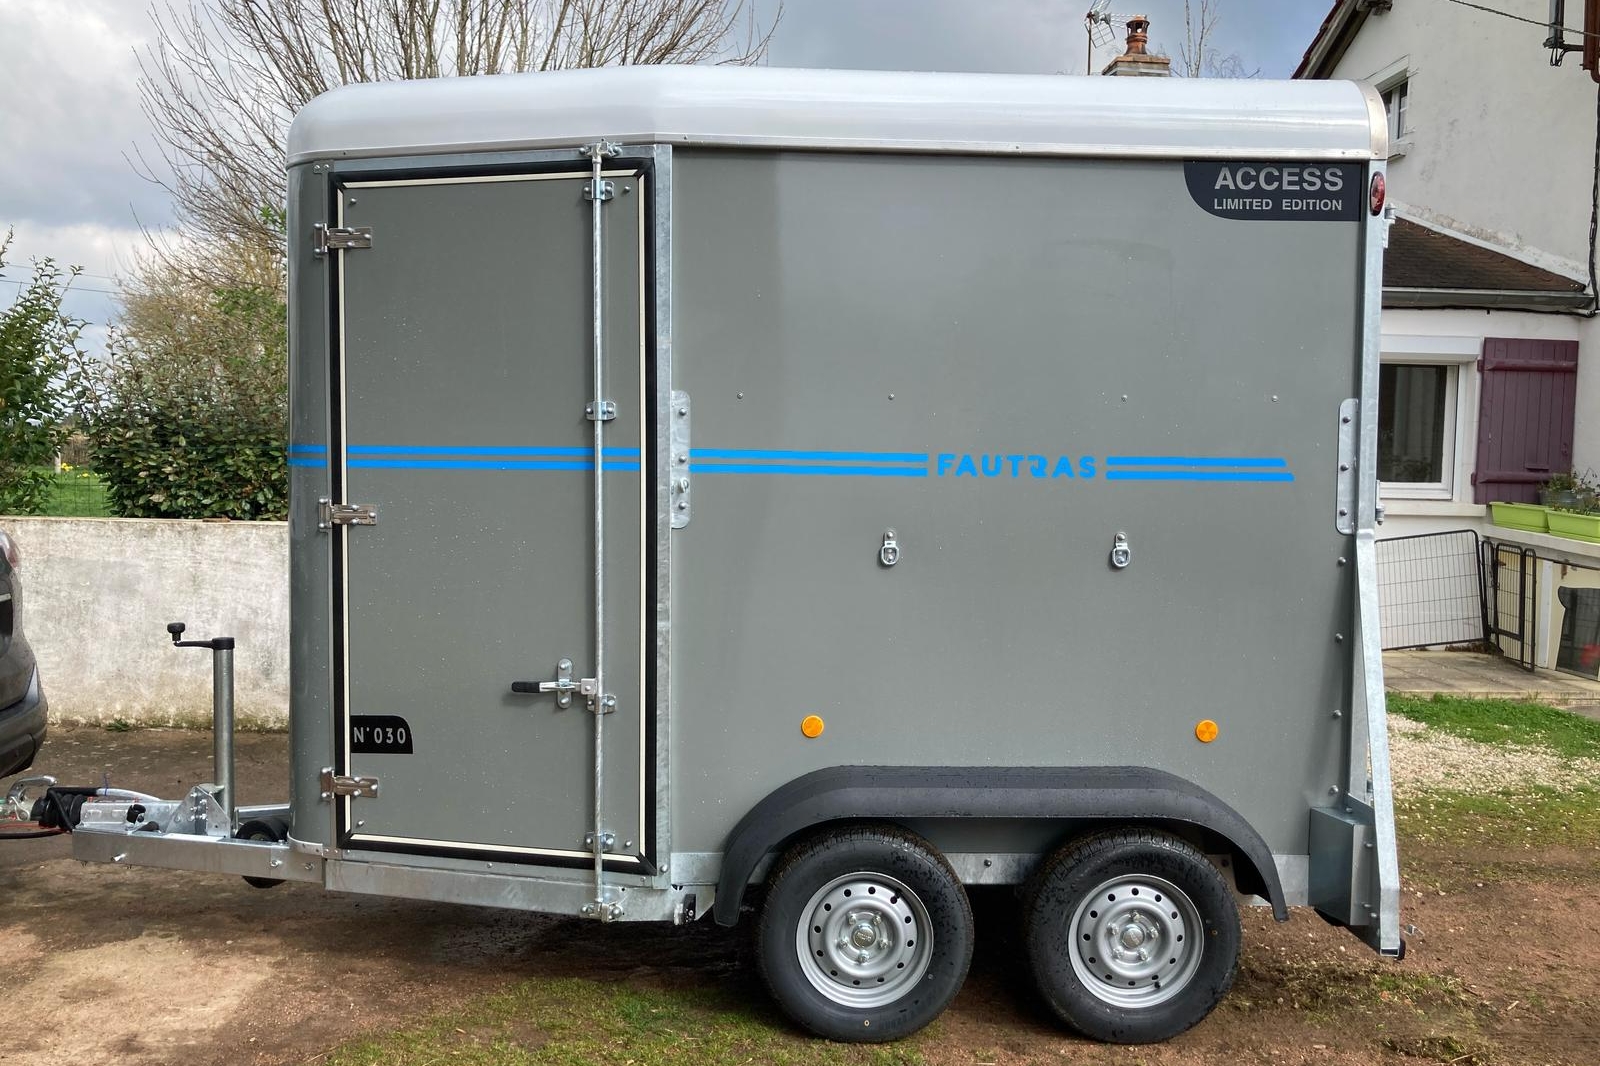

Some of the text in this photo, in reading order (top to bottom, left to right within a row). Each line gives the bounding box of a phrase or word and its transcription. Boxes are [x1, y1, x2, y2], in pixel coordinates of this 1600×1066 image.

[1214, 166, 1343, 191] ACCESS
[1214, 198, 1342, 211] LIMITED EDITION
[937, 453, 1097, 479] FAUTRAS
